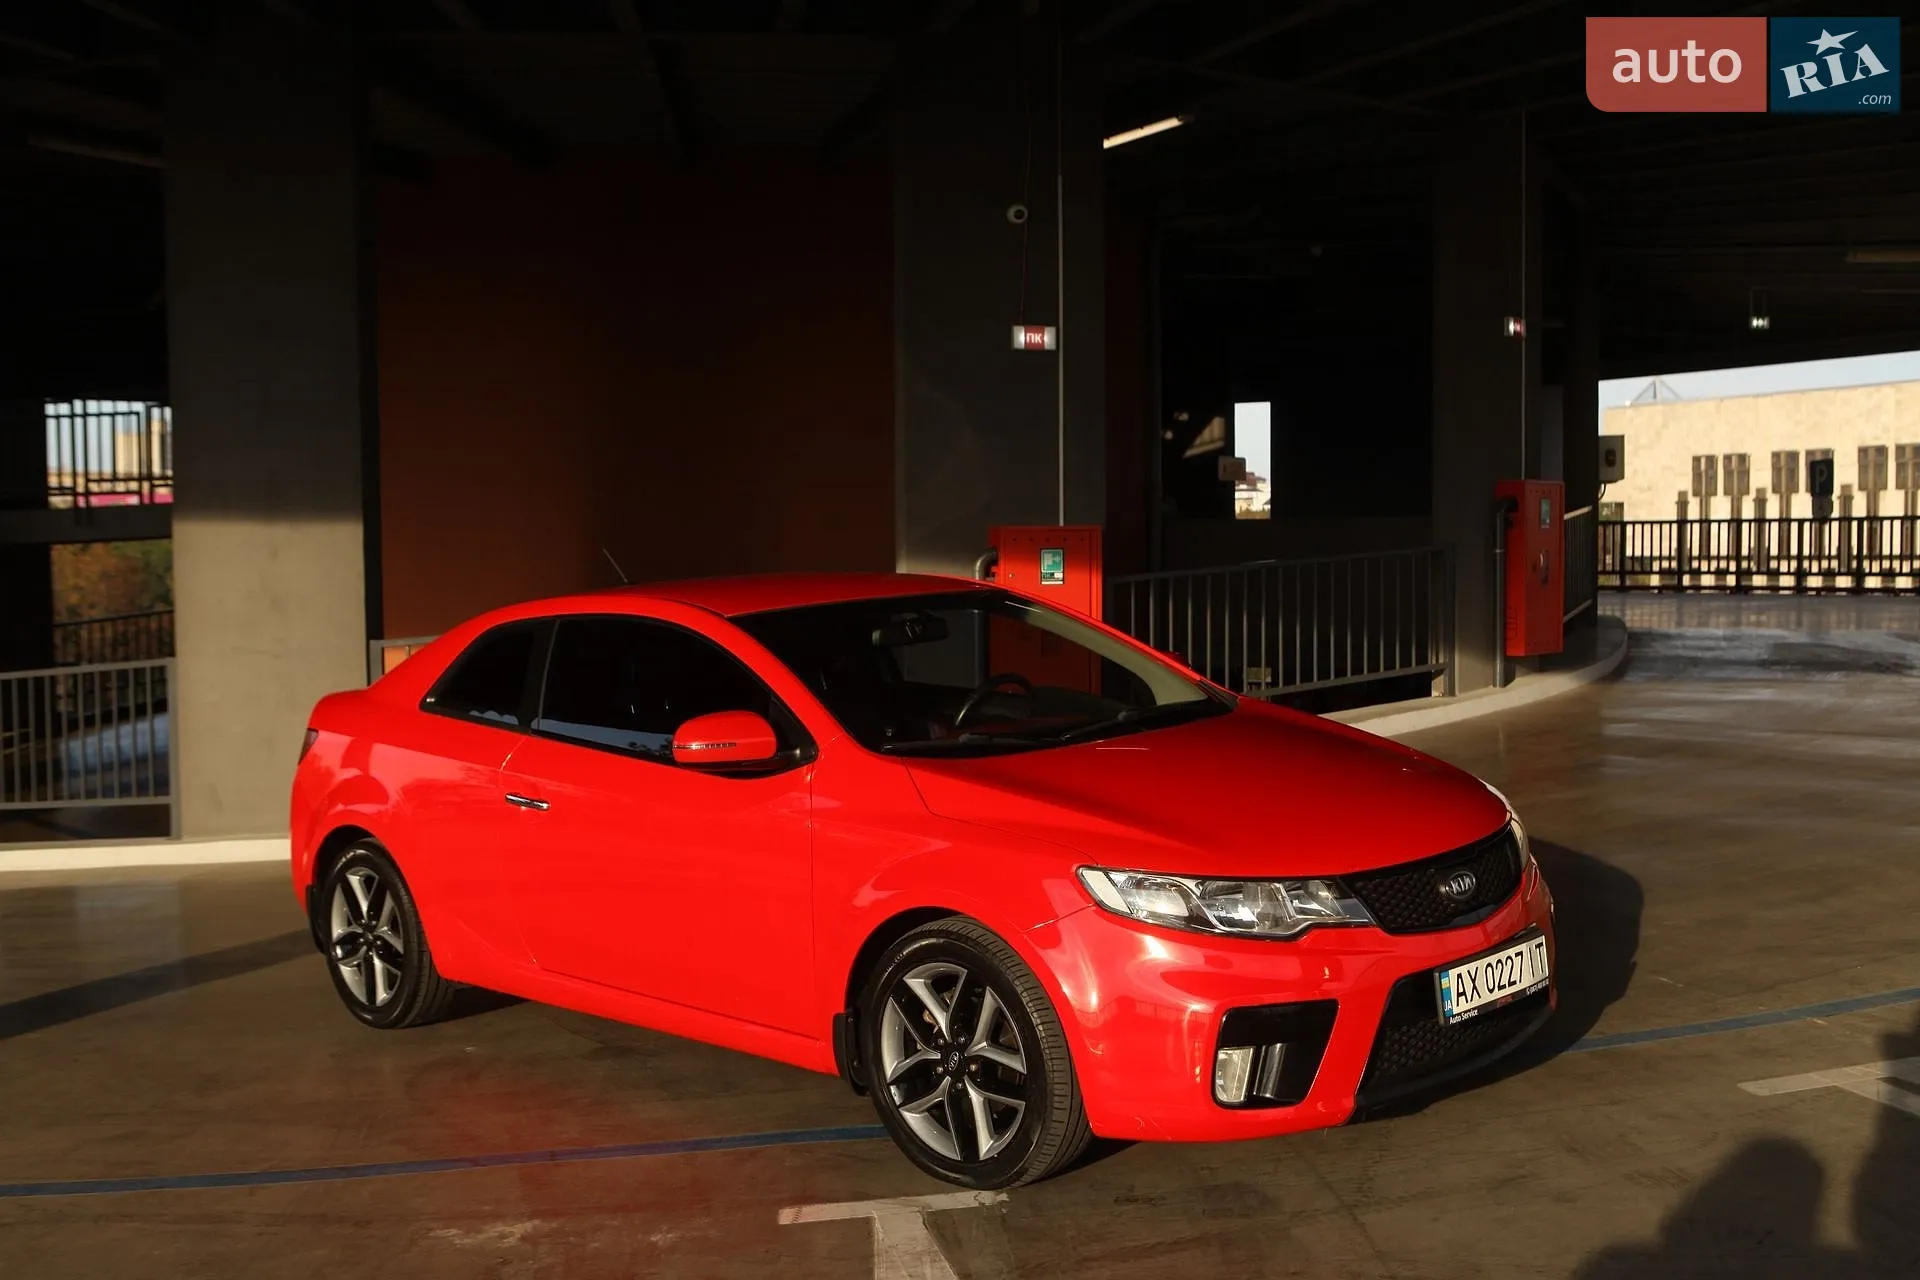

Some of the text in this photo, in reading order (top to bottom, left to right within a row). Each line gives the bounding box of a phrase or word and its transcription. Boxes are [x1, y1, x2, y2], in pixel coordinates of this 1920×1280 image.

[1026, 332, 1042, 344] ПК
[1450, 876, 1472, 894] KIA
[1456, 966, 1482, 1007] AX
[1484, 951, 1524, 994] 0227
[1449, 1009, 1478, 1025] Auto Service
